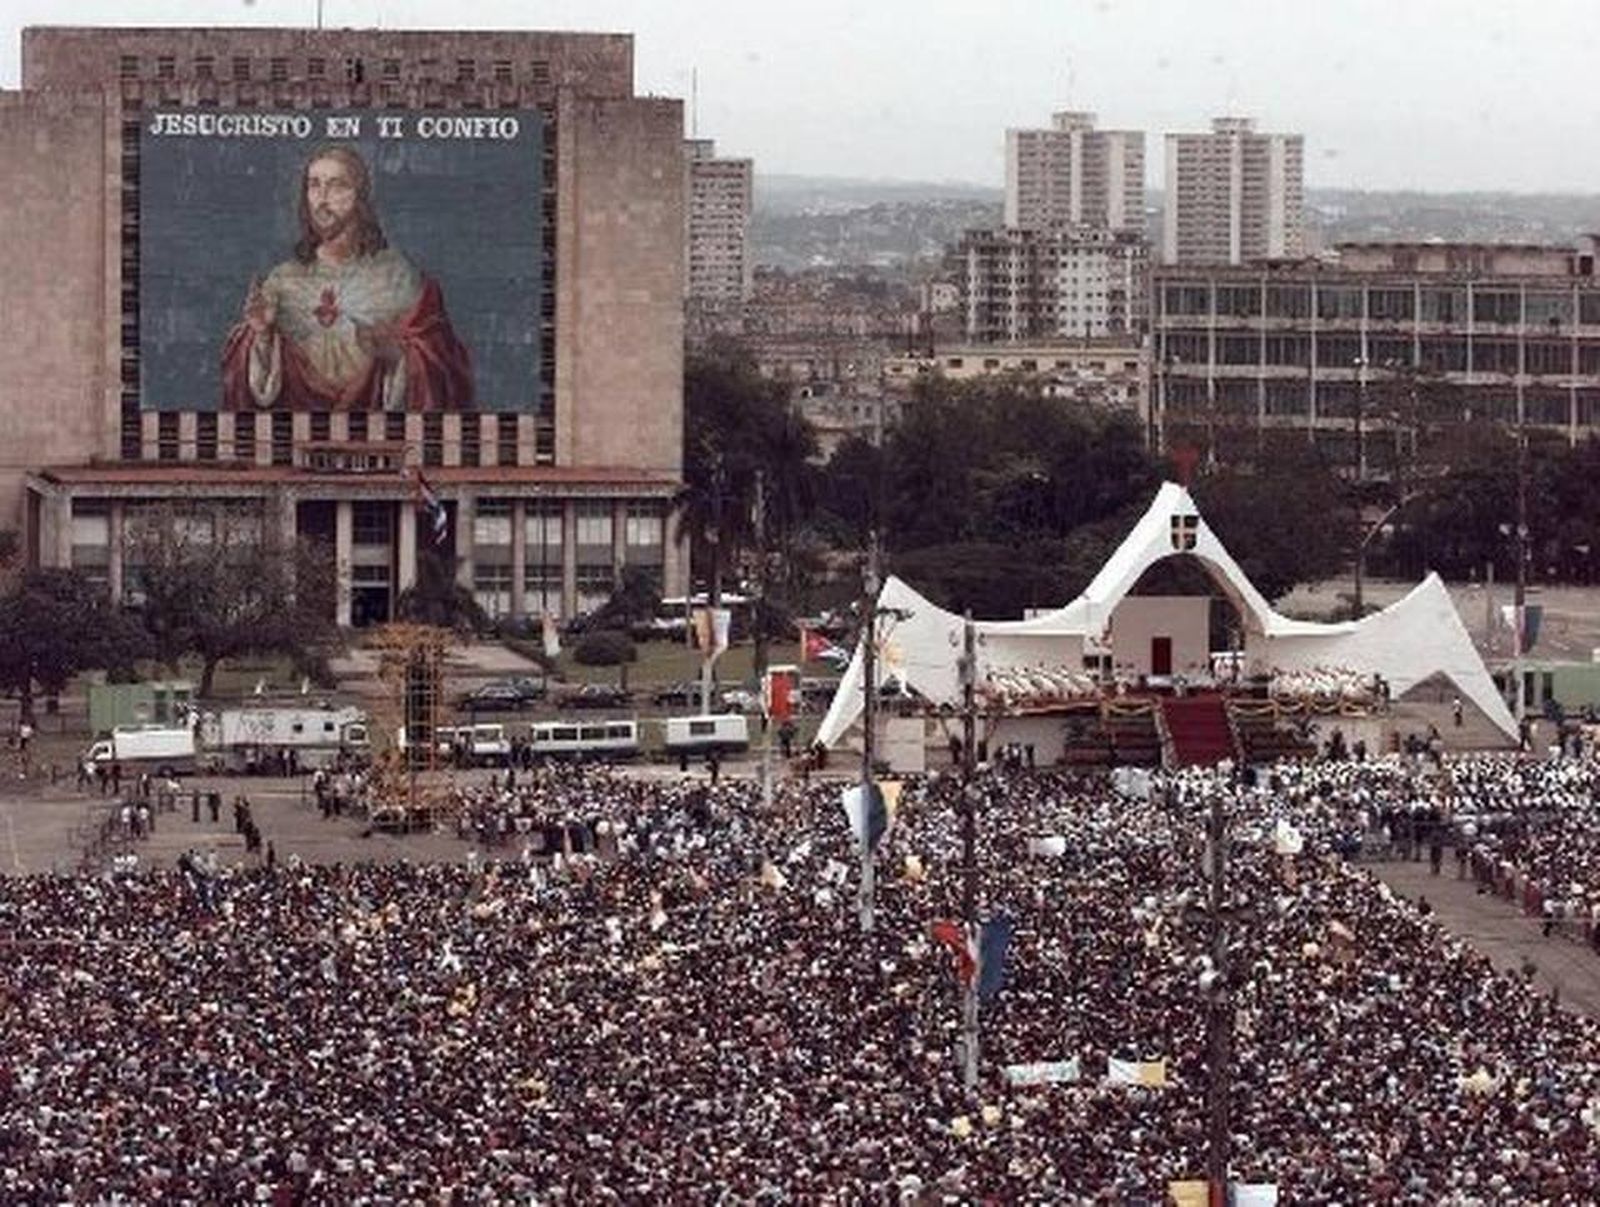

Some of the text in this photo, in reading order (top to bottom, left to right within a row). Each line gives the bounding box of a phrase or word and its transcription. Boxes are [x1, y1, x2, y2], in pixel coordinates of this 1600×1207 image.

[150, 113, 520, 139] JESUCRISTO EN TI CONFIO
